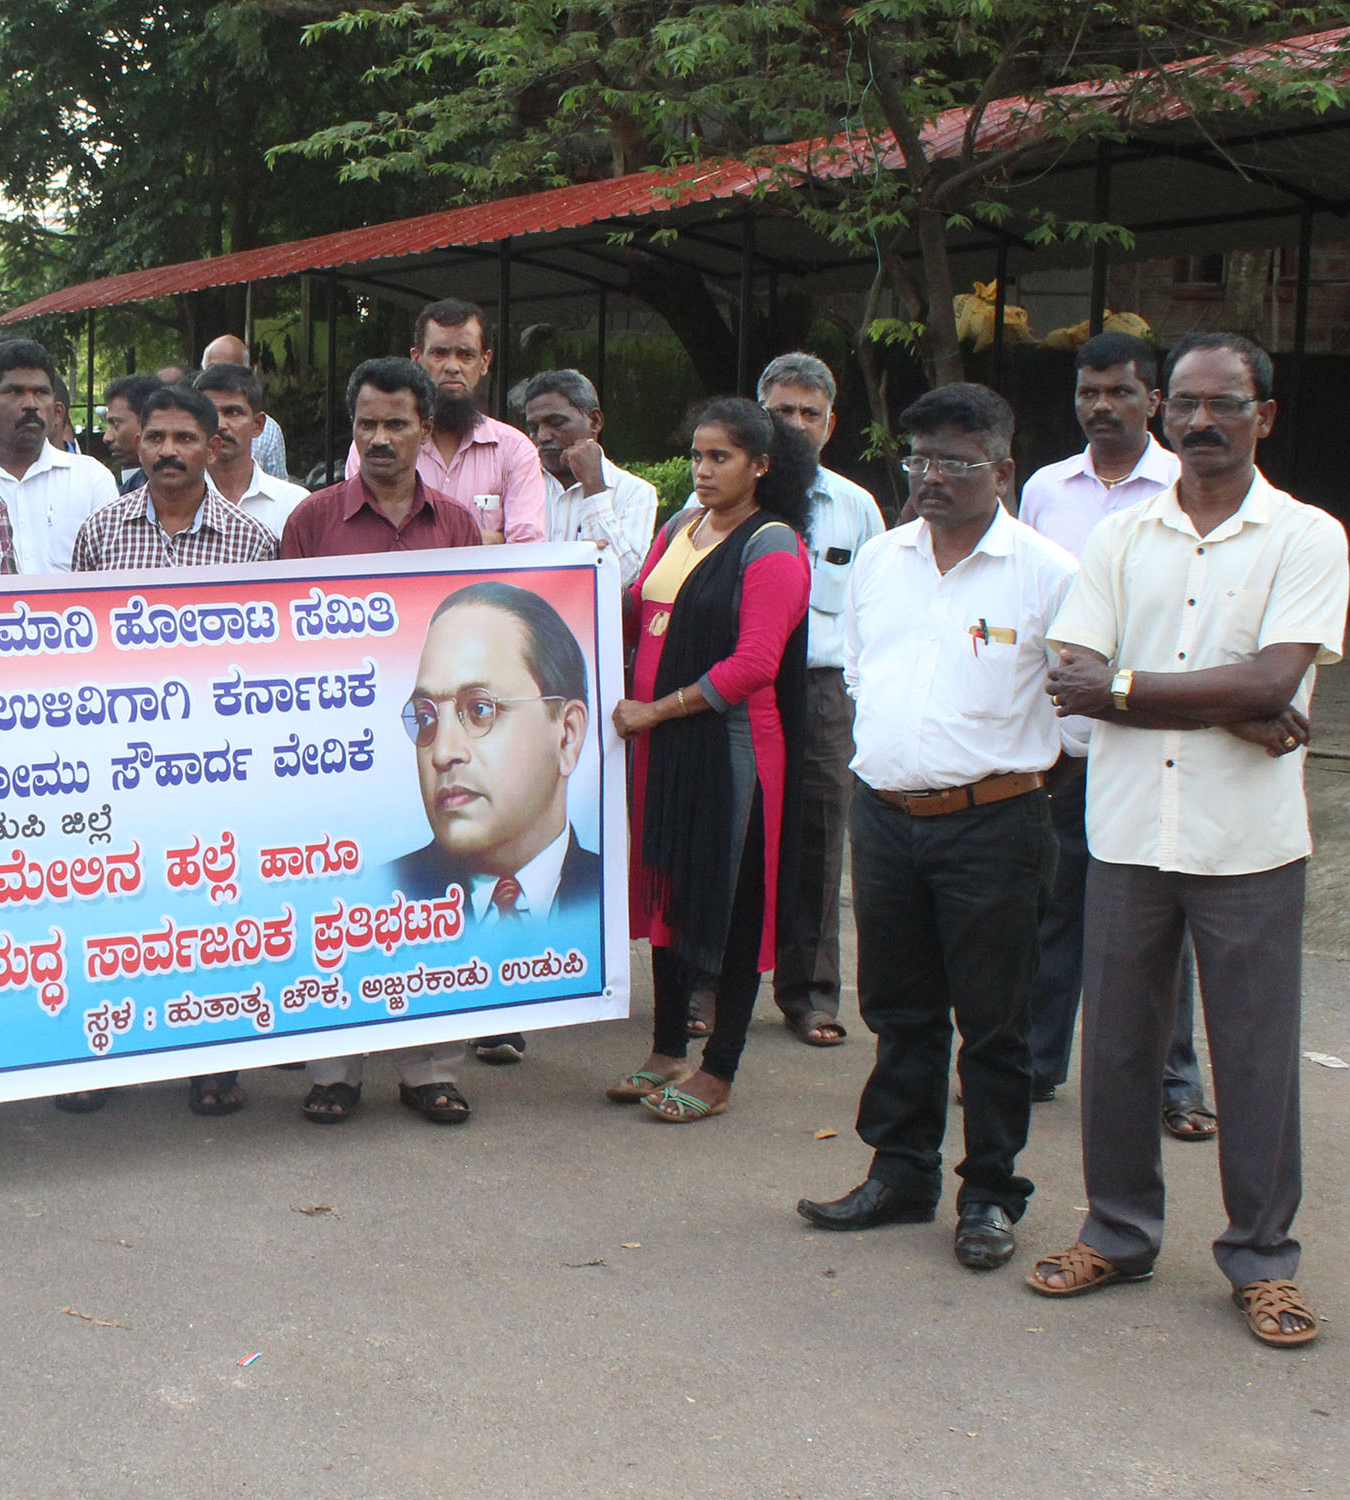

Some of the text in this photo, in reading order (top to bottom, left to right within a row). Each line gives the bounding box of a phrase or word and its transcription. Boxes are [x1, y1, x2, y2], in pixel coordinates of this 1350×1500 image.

[116, 600, 275, 645] ಹೋರಾಟ
[296, 592, 394, 636] ಸಮಿತಿ
[213, 662, 376, 715] ಕರ್ನಾಟಕ
[111, 738, 252, 790] ಸೌಹಾರ್ದ
[274, 728, 374, 777] ವೇದಿಕೆ
[62, 804, 111, 844] ಜಿಲ್ಲೆ
[166, 832, 237, 902] ಹಲ್ಲೆ
[261, 834, 358, 878] ಹಾಗೂ
[87, 905, 293, 982] ಸಾರ್ವಜನಿಕ
[314, 887, 464, 968] ಪ್ರತಿಭಟನೆ
[88, 1002, 132, 1050] ಸ್ಥಳ
[169, 987, 270, 1027] ಹುತಾತ್ಮ
[283, 976, 348, 1009] ಚೌಕ,
[362, 958, 488, 1011] ಅಜ್ಜರಕಾಡು
[502, 951, 583, 981] ಉಡುಪಿ
